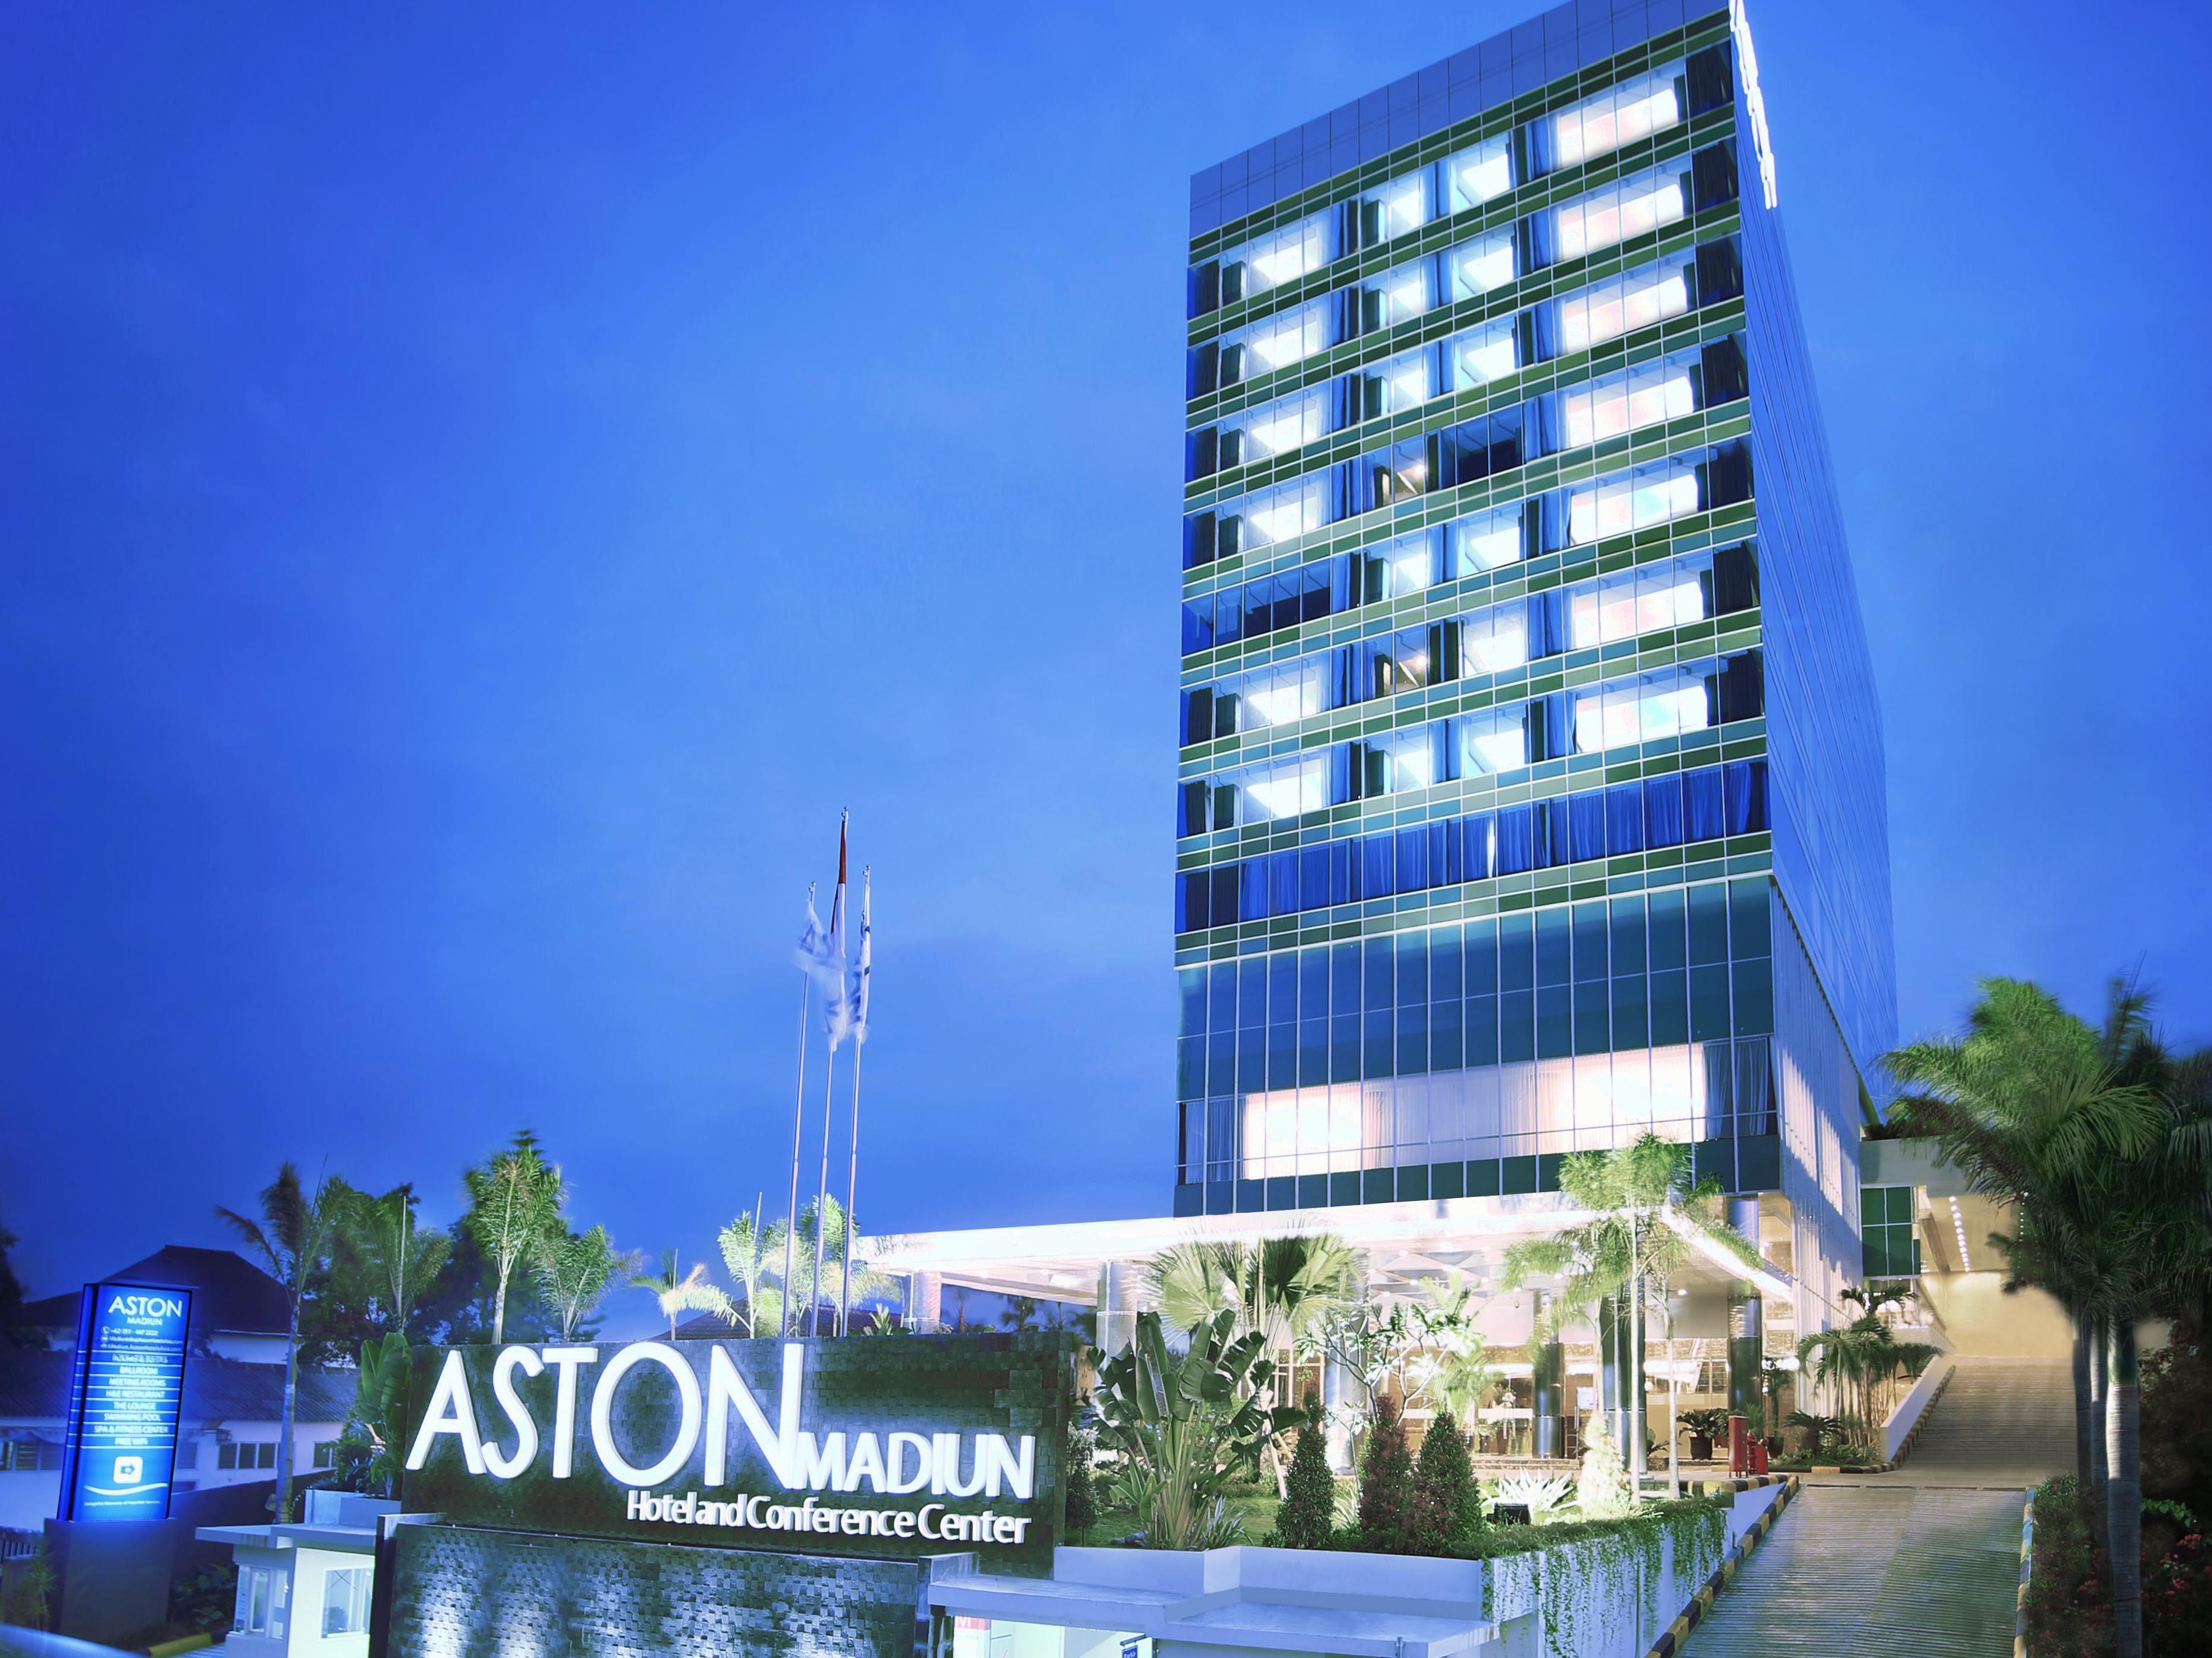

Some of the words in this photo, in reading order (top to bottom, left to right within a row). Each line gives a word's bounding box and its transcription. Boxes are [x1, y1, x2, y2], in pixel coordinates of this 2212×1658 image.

[108, 1296, 183, 1317] ASTON
[127, 1317, 163, 1325] MADIUN
[120, 1366, 159, 1374] BALLROOM
[122, 1390, 166, 1398] RESTAURANT
[405, 1342, 804, 1490] ASTON
[798, 1430, 1036, 1499] MADIUN
[114, 1437, 131, 1445] FREE
[627, 1490, 697, 1524] Hotel
[695, 1493, 748, 1527] and
[746, 1496, 917, 1538] Conference
[917, 1504, 1031, 1544] Center
